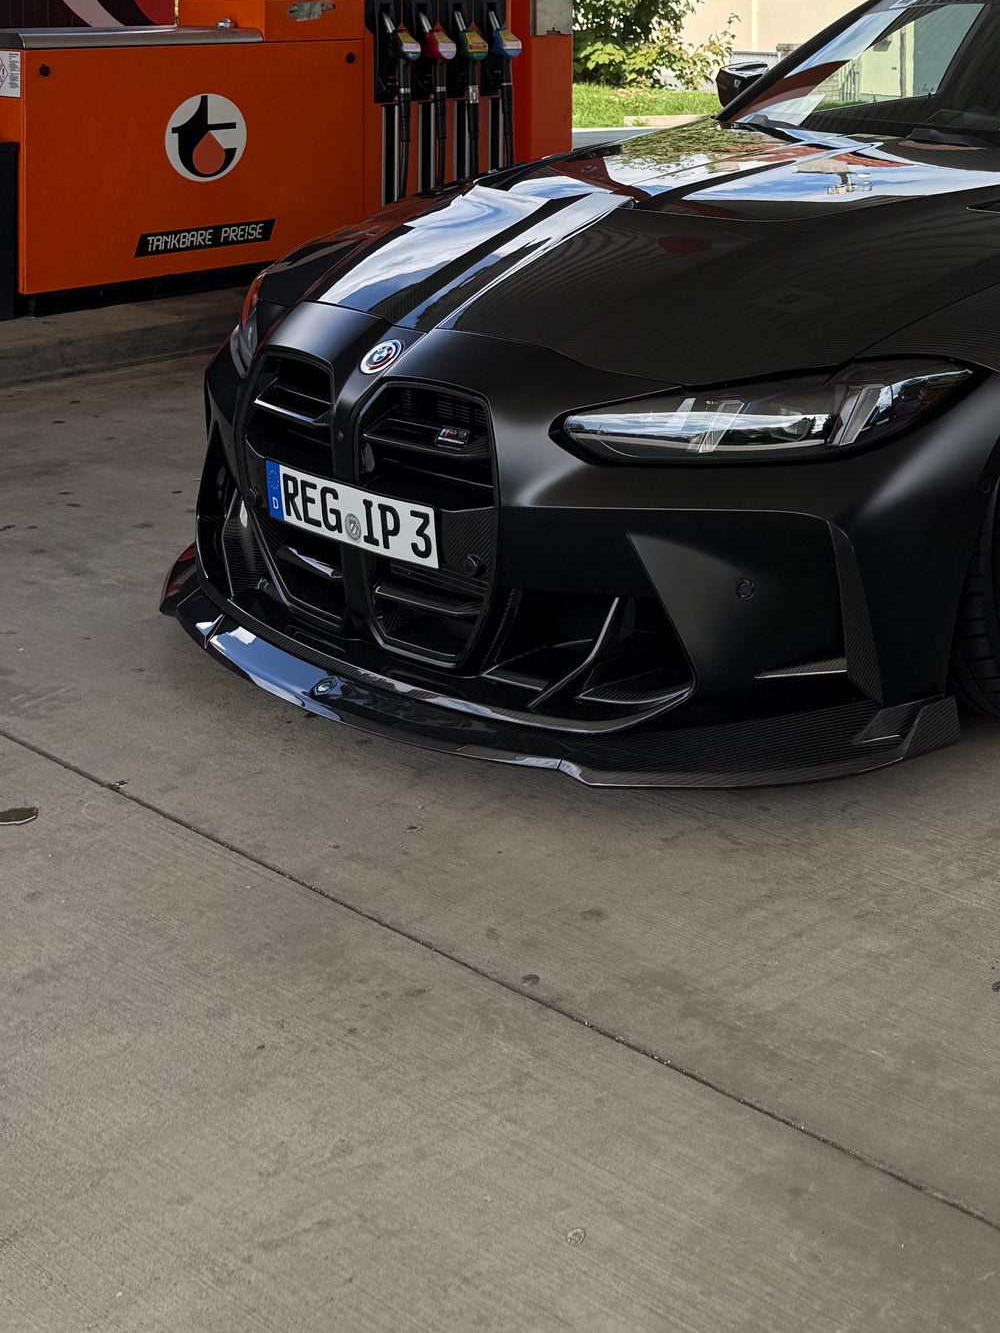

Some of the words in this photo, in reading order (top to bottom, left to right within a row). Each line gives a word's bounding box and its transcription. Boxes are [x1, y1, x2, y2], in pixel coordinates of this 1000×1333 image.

[147, 229, 214, 252] TANKBARE
[220, 223, 265, 243] PREISE
[272, 497, 279, 510] D
[283, 473, 343, 534] REG
[362, 499, 400, 550] IP
[410, 510, 433, 559] 3
